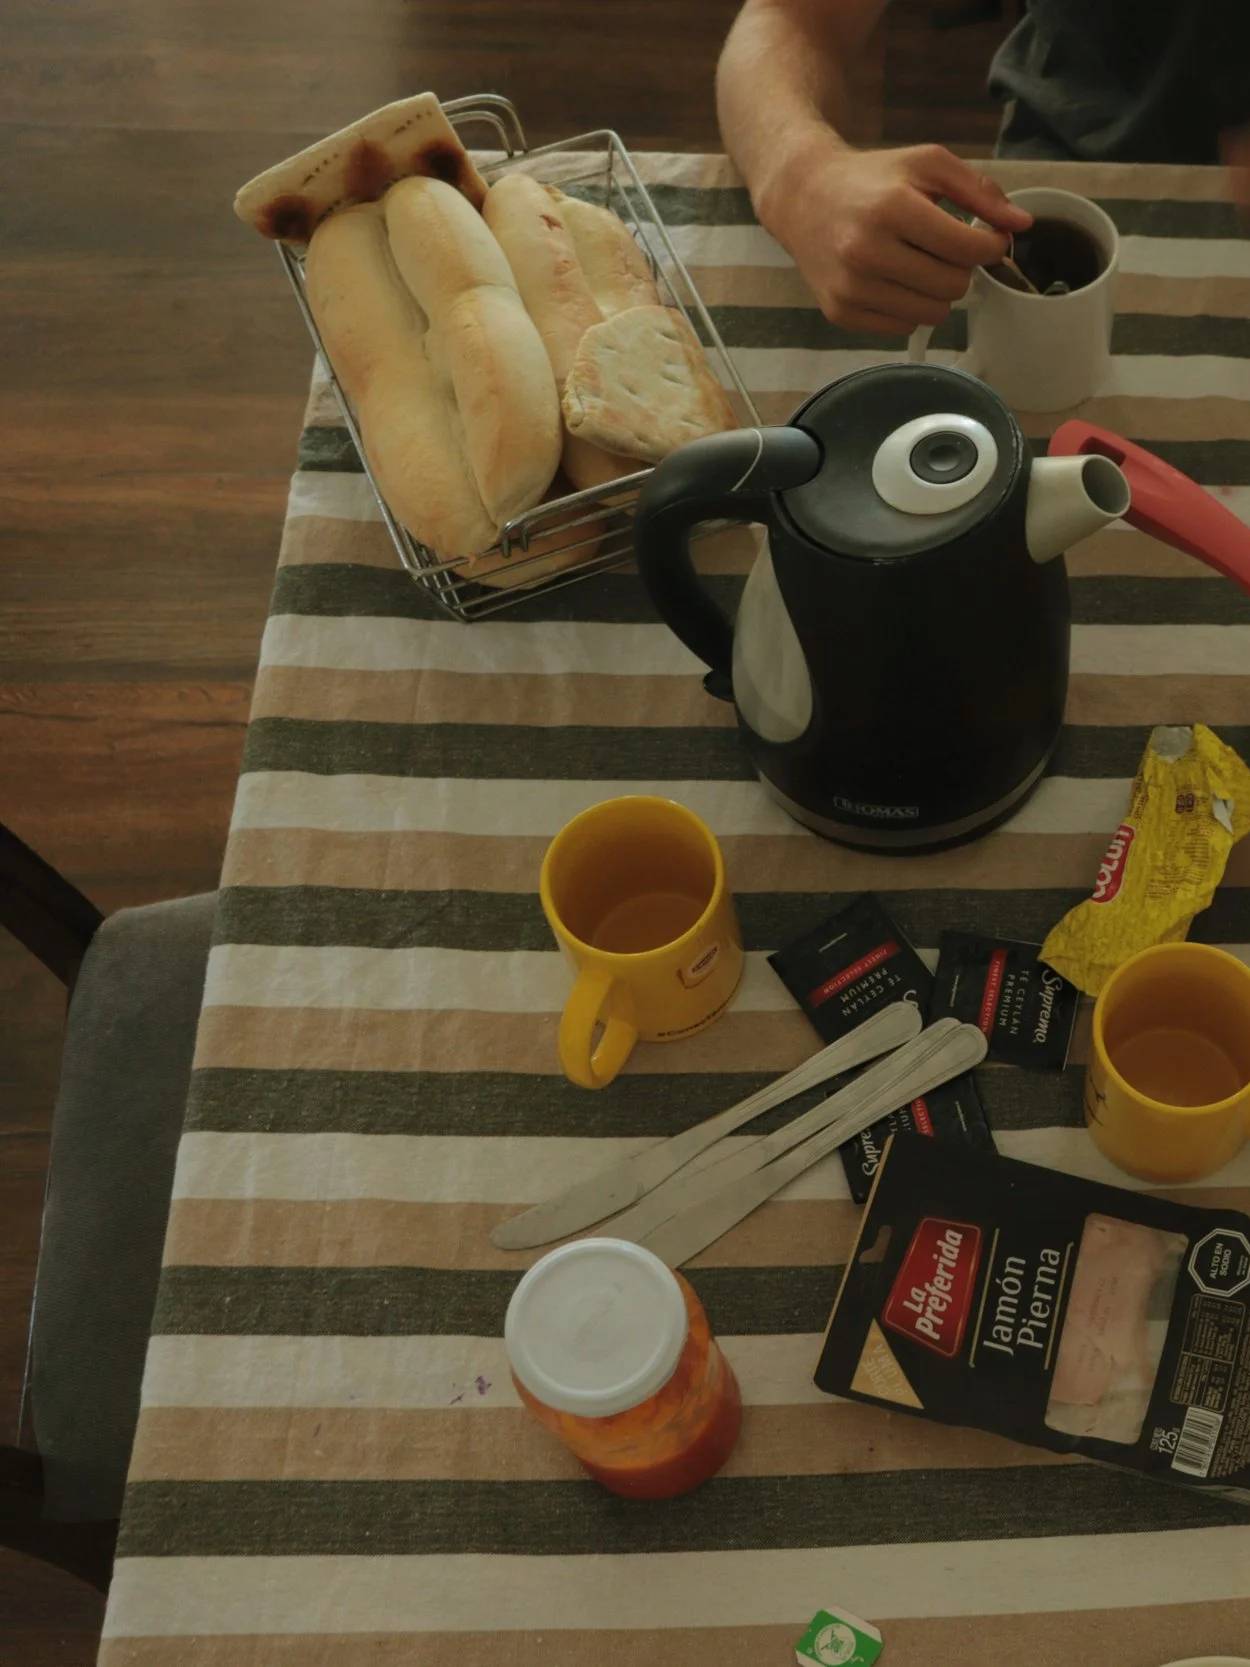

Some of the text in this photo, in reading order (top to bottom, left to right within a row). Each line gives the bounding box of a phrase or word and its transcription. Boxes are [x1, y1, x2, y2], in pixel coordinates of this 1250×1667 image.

[840, 967, 889, 1003] PREMIUM
[982, 960, 1001, 1033] FINEST SELECTION
[999, 974, 1017, 1026] PREMIUM
[1033, 969, 1064, 1043] Supremo
[861, 1130, 882, 1176] Supre
[914, 1228, 964, 1341] Preferida
[1208, 1242, 1225, 1280] ALTO EN
[1219, 1249, 1232, 1277] SODIO
[902, 1286, 928, 1314] La
[983, 1255, 1027, 1356] Jamón
[1016, 1248, 1061, 1349] Pierna
